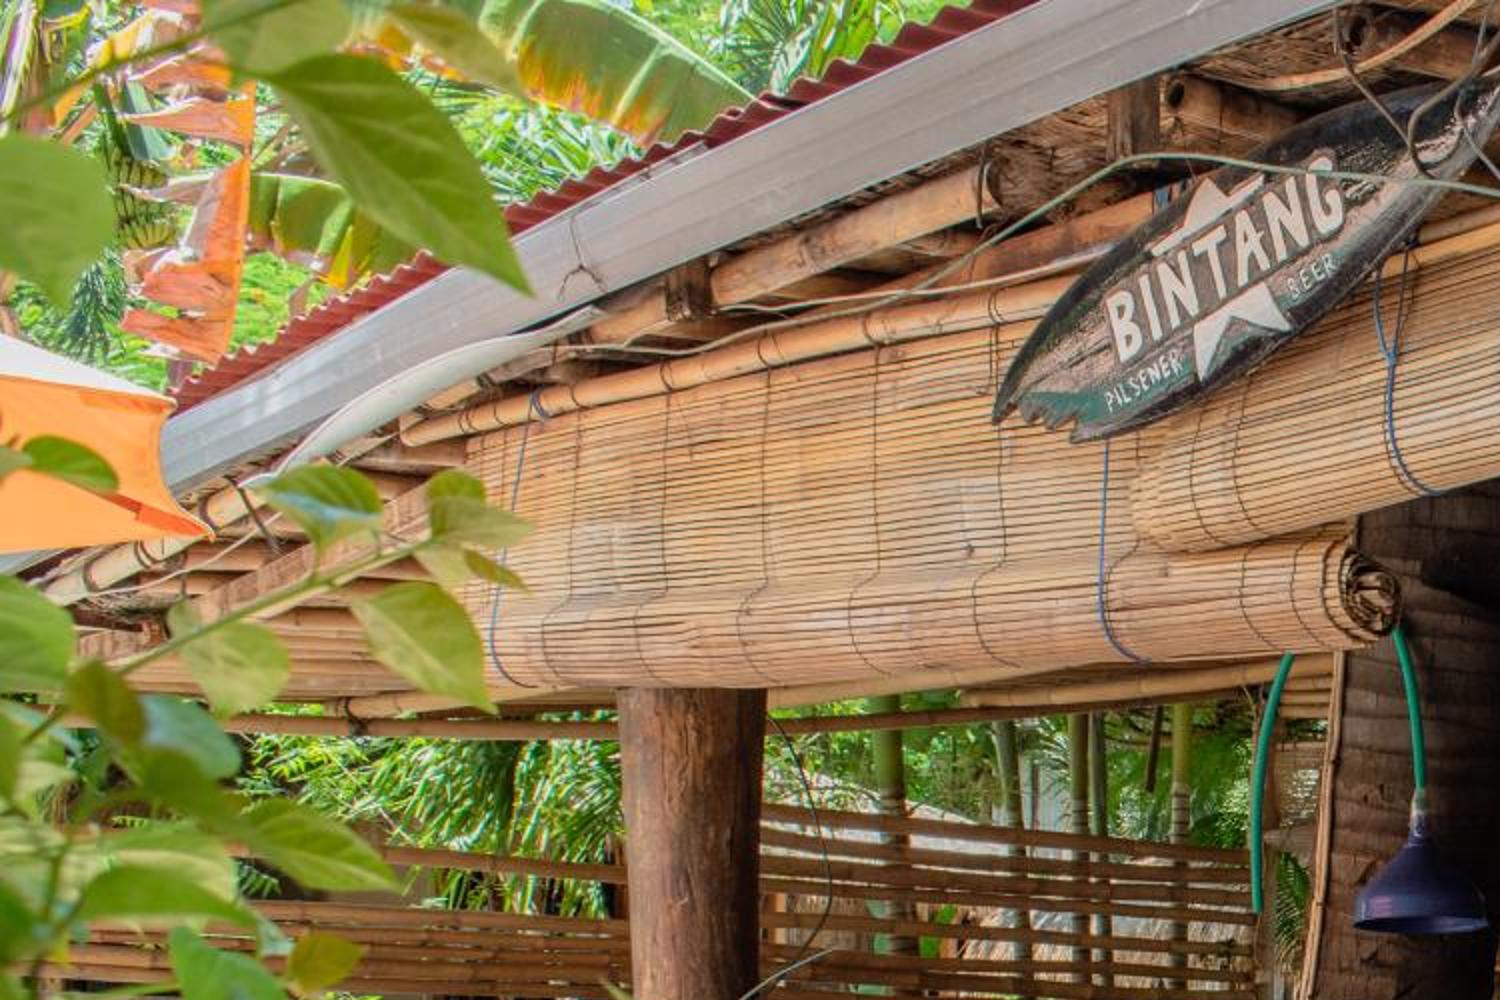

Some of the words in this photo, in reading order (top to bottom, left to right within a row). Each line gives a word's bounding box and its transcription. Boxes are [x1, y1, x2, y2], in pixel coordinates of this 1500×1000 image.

[1105, 157, 1345, 364] BINTANG
[1284, 255, 1338, 304] BEER
[1105, 348, 1184, 412] PILSENER
